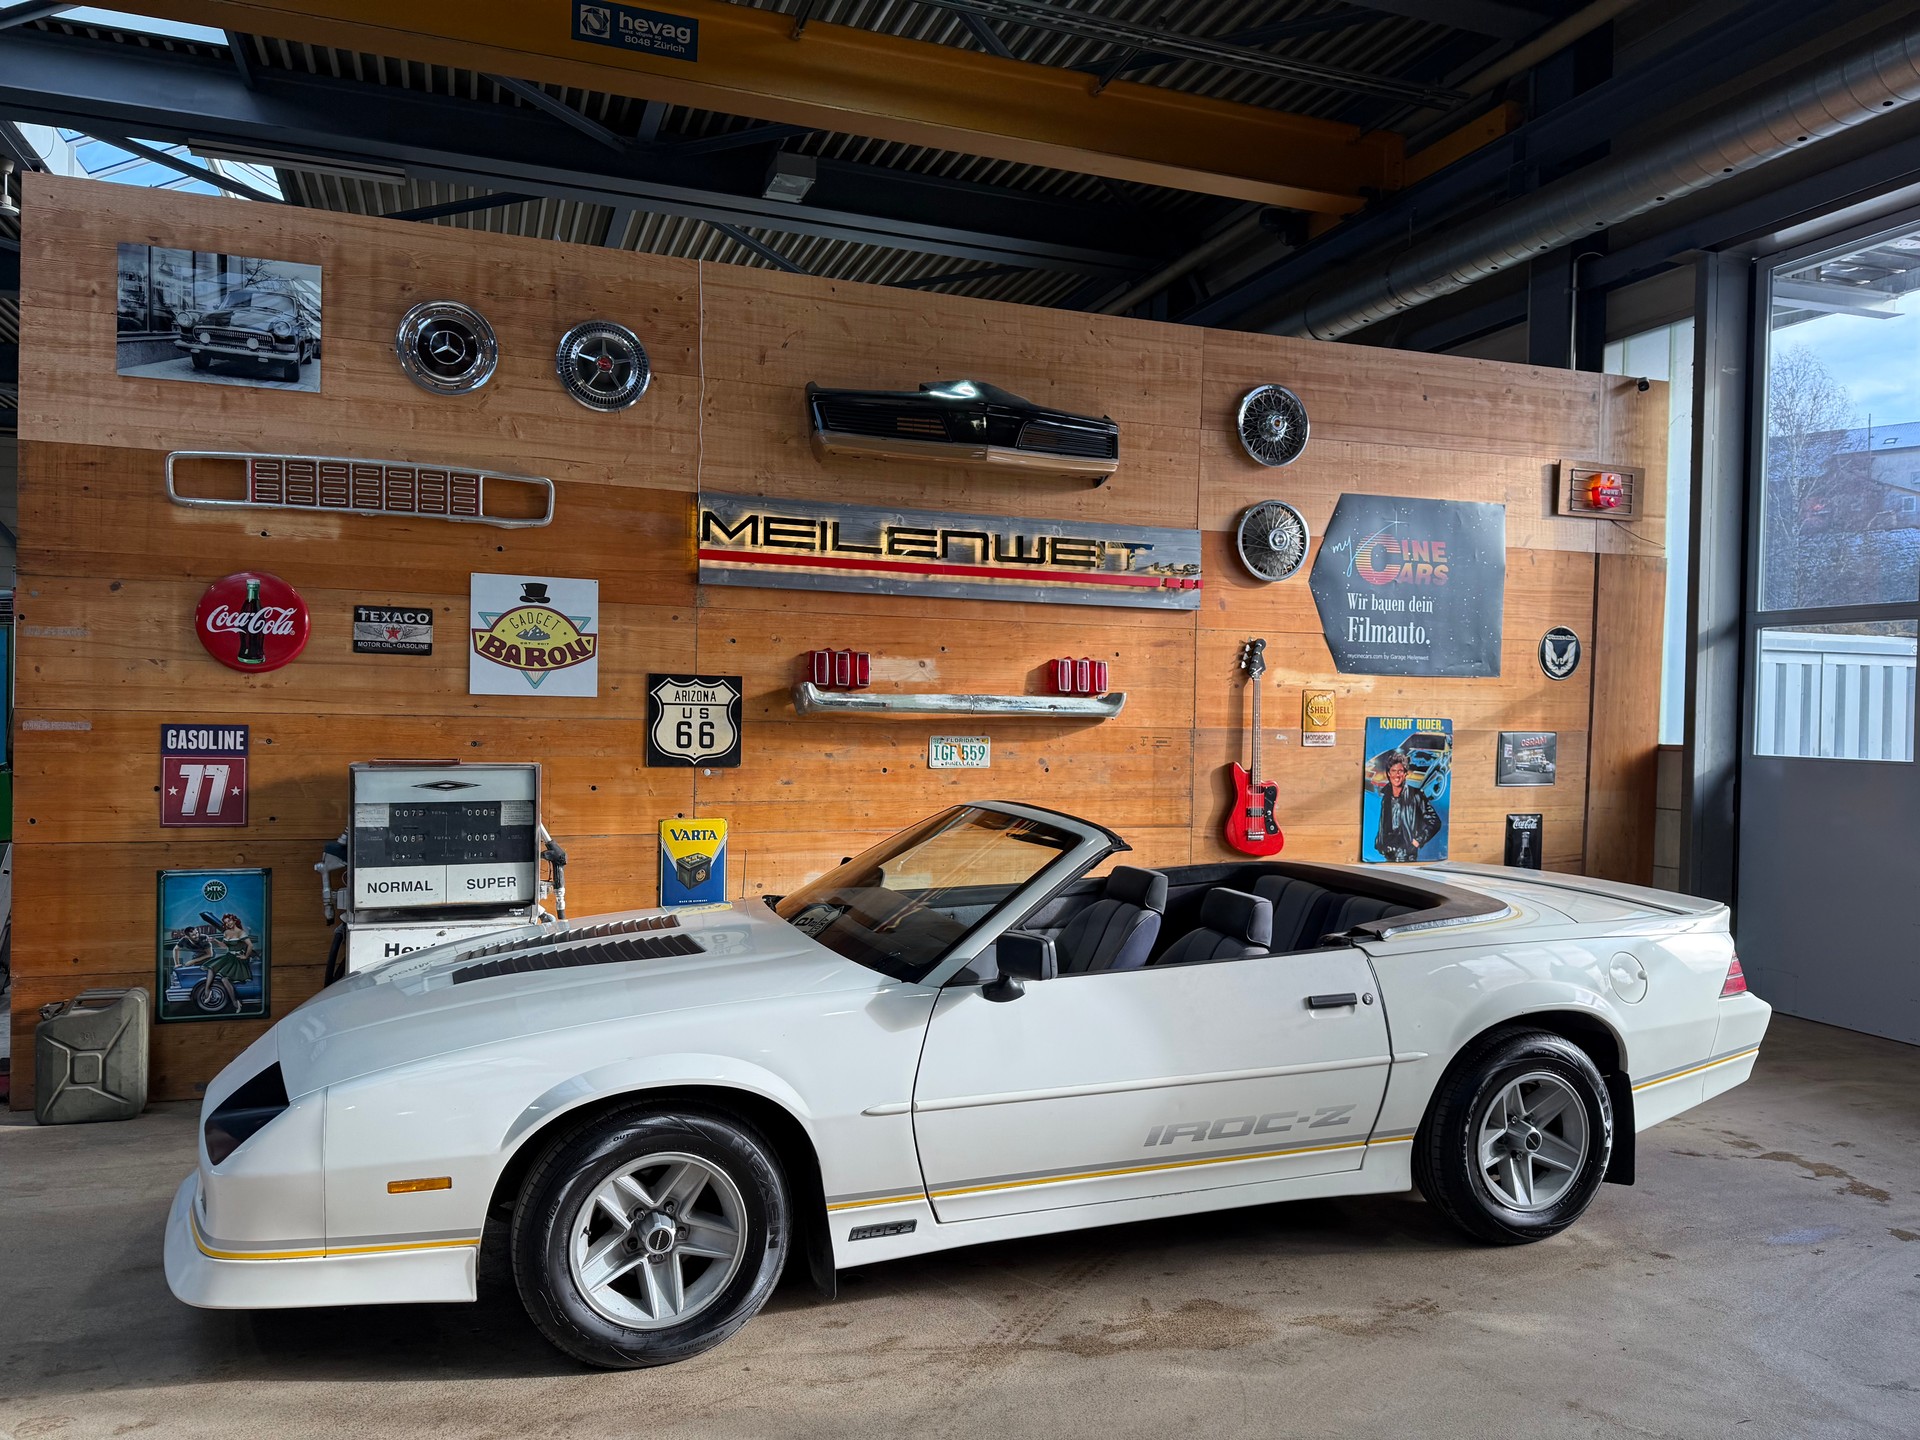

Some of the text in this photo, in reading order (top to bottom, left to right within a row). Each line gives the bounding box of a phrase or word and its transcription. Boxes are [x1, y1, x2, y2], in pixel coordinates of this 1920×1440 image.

[619, 11, 691, 44] hevag
[624, 35, 685, 53] 8048 Zürich
[1347, 592, 1433, 613] Wir bauen dein
[206, 604, 298, 635] Coca-Cola
[358, 610, 430, 624] TEXACO
[509, 611, 562, 631] GADGET
[1347, 616, 1431, 645] Filmauto.
[479, 634, 592, 667] BARON
[1390, 653, 1406, 661] Garage
[674, 690, 717, 702] ARIZONA
[1310, 706, 1330, 714] SHELL
[1379, 718, 1413, 730] KNIGHT
[166, 729, 245, 750] GASOLINE
[676, 721, 715, 749] 66
[1520, 736, 1547, 748] OSRAM
[961, 744, 986, 761] 559
[179, 764, 231, 816] 77
[1512, 818, 1538, 830] Coca-Cola
[669, 828, 718, 841] VARTA
[367, 876, 517, 894] NORMAL SUPER
[1143, 1104, 1357, 1147] IROC-Z
[731, 1136, 781, 1249] NEXEN
